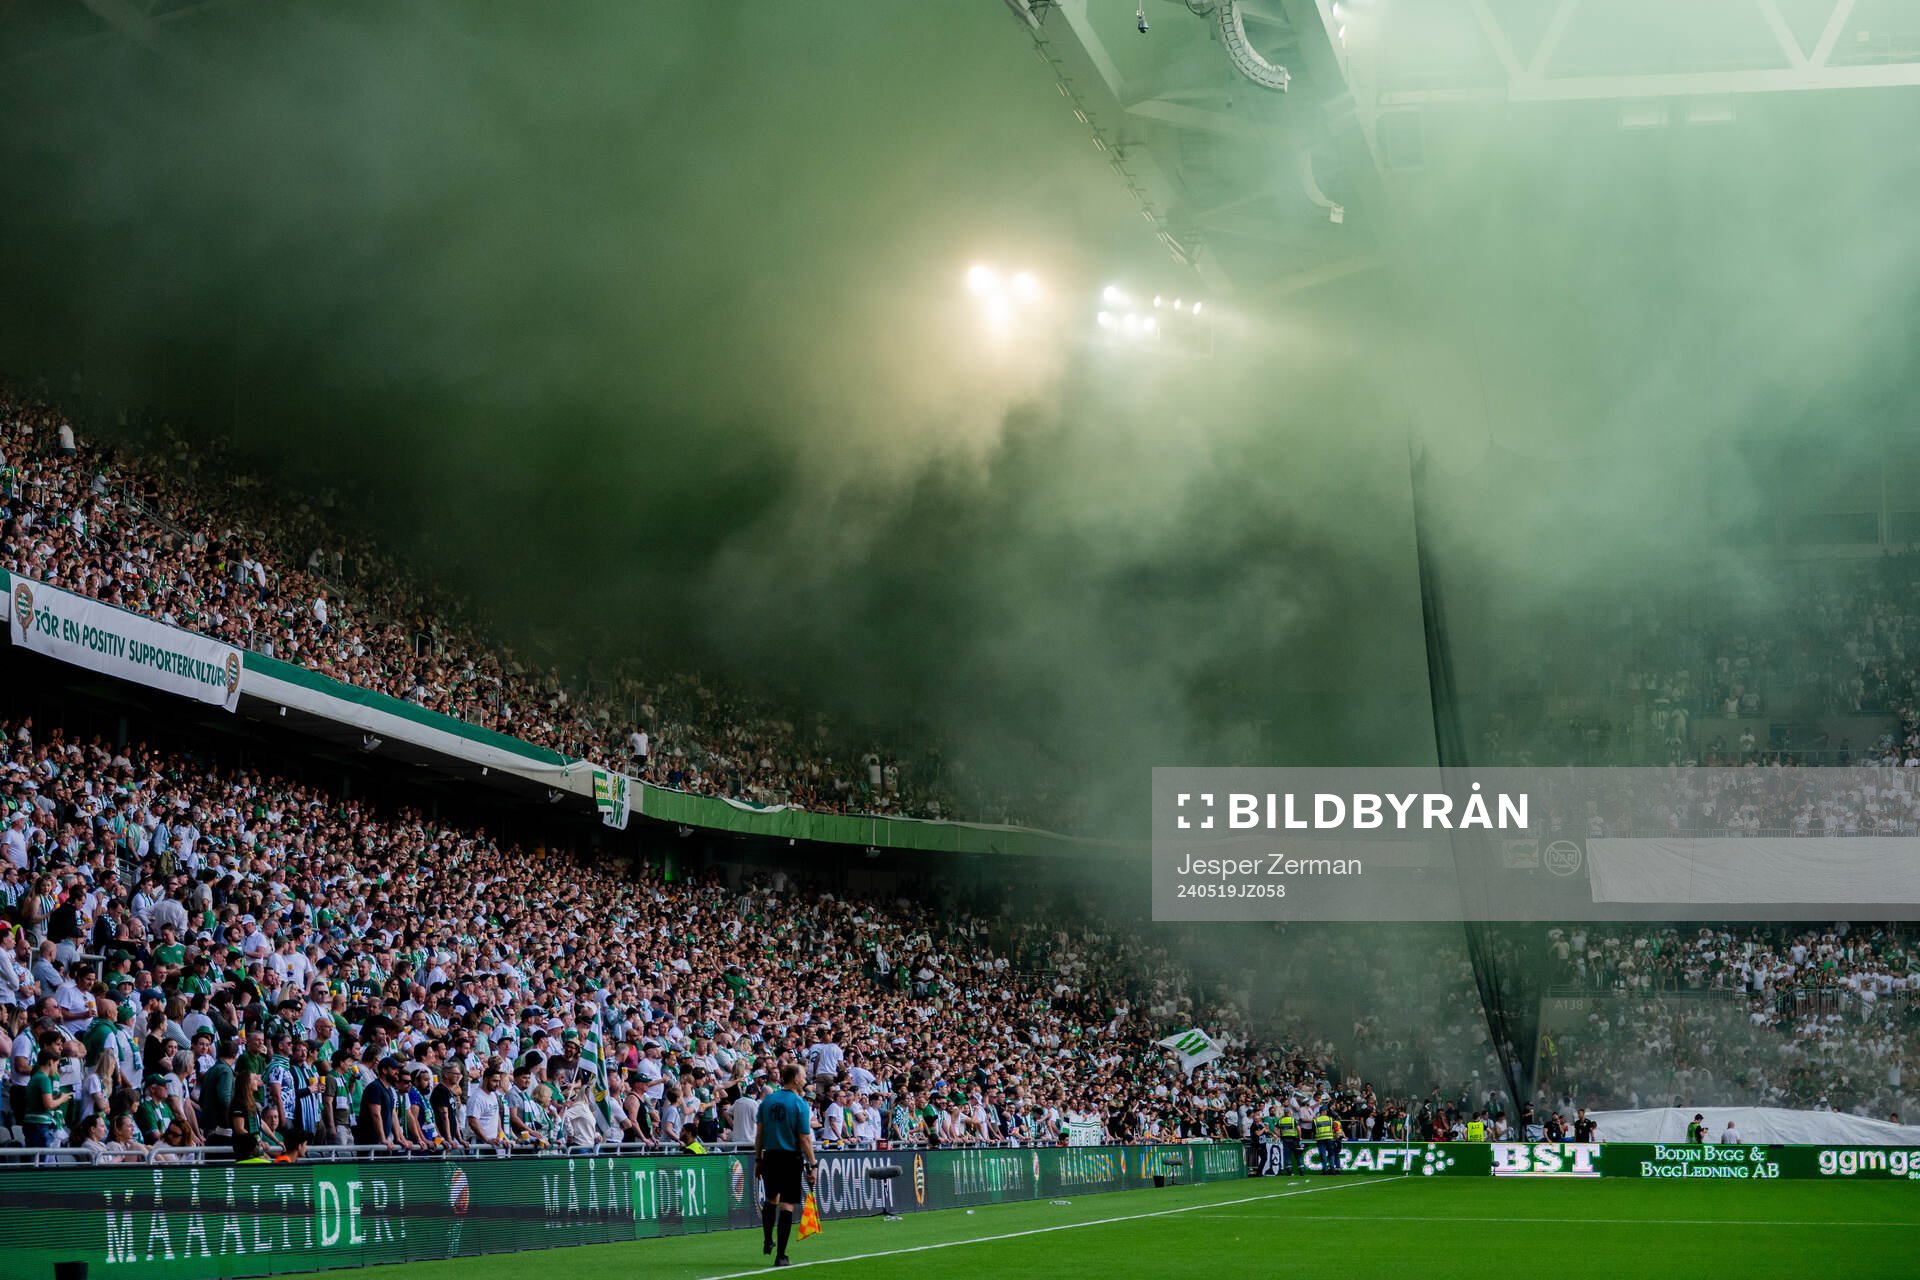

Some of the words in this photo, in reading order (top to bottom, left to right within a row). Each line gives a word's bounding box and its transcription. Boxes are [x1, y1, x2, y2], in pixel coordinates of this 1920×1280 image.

[34, 604, 60, 639] FÖR
[63, 618, 80, 644] EN
[82, 624, 126, 658] POSITIV
[1304, 1148, 1421, 1170] CRAFT
[1491, 1143, 1600, 1173] BST
[1749, 1146, 1767, 1161] &
[1751, 1162, 1780, 1179] AB
[801, 1156, 894, 1214] OCKHOLM
